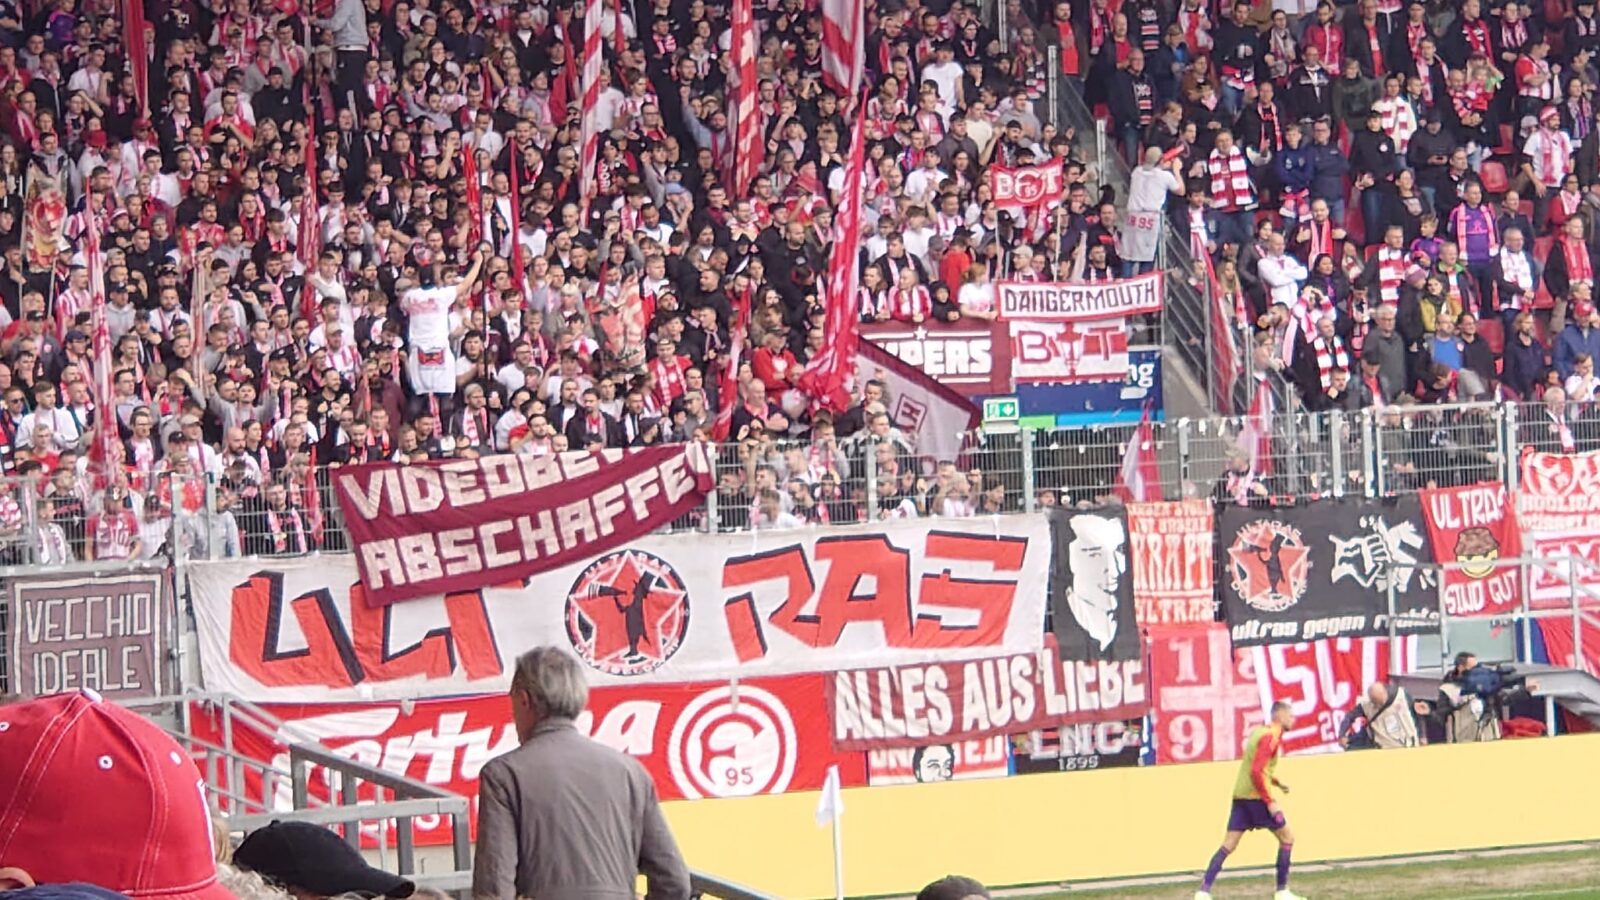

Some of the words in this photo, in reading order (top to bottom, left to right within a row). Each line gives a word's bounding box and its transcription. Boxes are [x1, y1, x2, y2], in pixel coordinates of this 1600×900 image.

[1004, 283, 1157, 313] DANGERMOUTH
[876, 340, 992, 375] PERS
[339, 447, 645, 520] VIDEOBE
[1130, 532, 1213, 590] KRAFT
[1135, 597, 1213, 623] ULTRAS
[1445, 580, 1485, 614] SIND
[1488, 570, 1518, 605] GUT
[25, 592, 151, 643] VECCHIO
[1232, 621, 1298, 641] ultras
[1303, 615, 1366, 640] gegen
[34, 645, 142, 694] IDEALE
[835, 664, 954, 740] ALLES
[962, 654, 1035, 732] AUS
[1042, 647, 1145, 715] LIEBE
[272, 701, 662, 813] Fortua
[869, 734, 1005, 768] UNTED
[725, 766, 754, 786] 95
